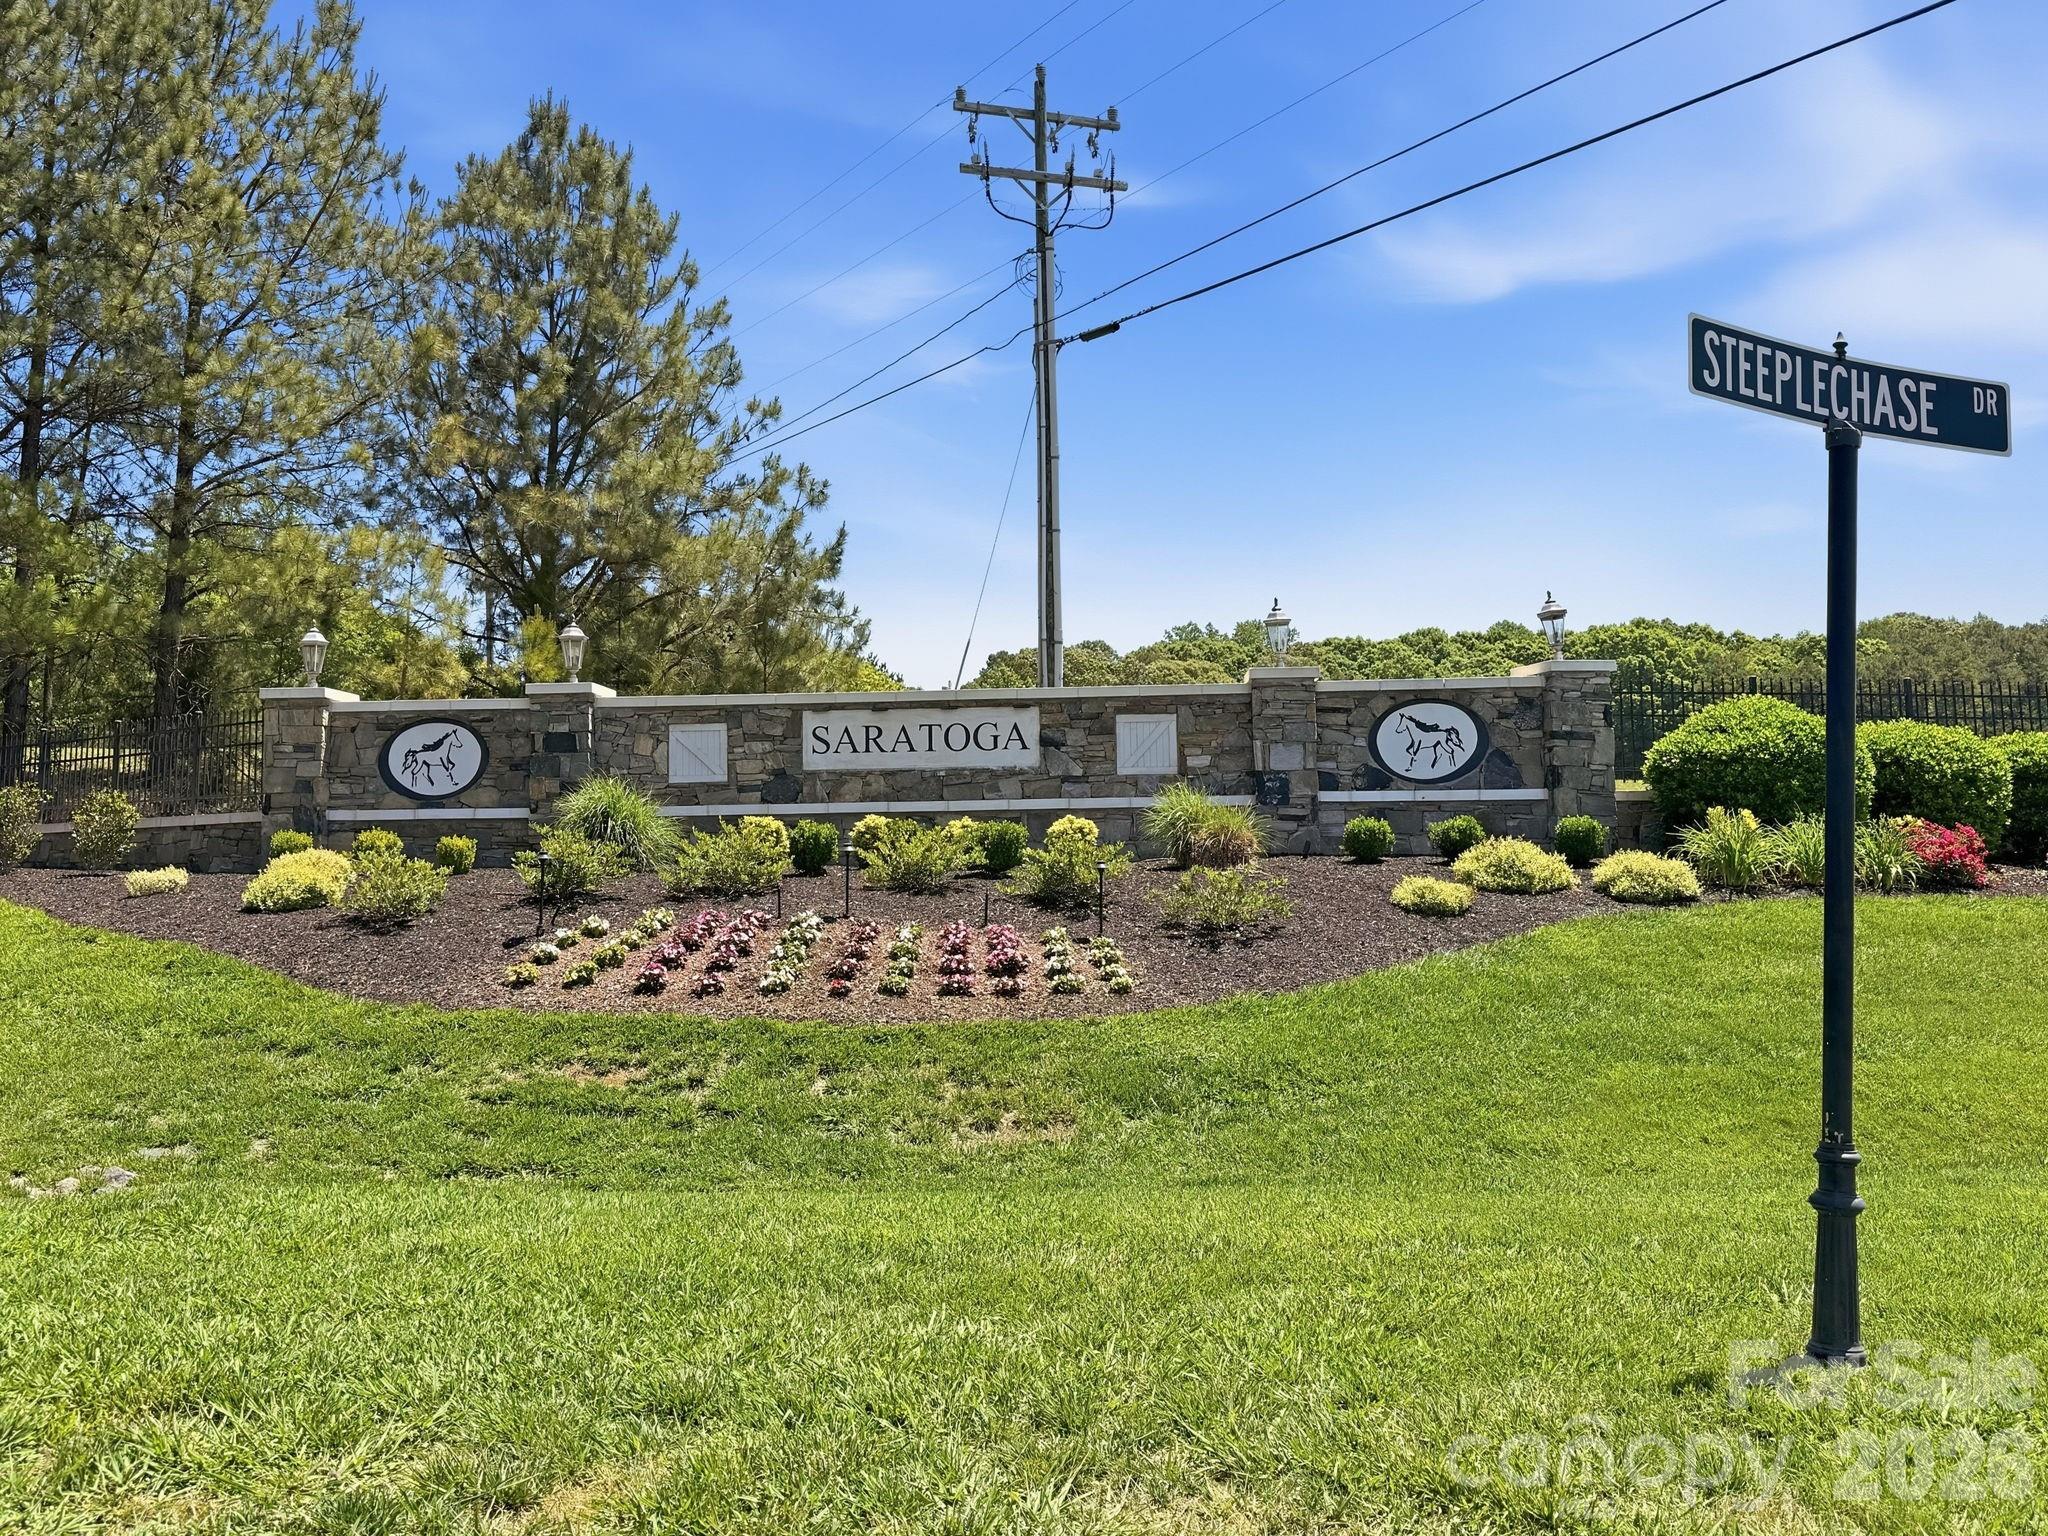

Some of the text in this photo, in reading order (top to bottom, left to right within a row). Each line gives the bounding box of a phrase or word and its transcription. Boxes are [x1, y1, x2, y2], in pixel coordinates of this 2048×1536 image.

[1703, 330, 1998, 435] STEEPLECHASE DR
[811, 721, 1030, 755] SARATOGA
